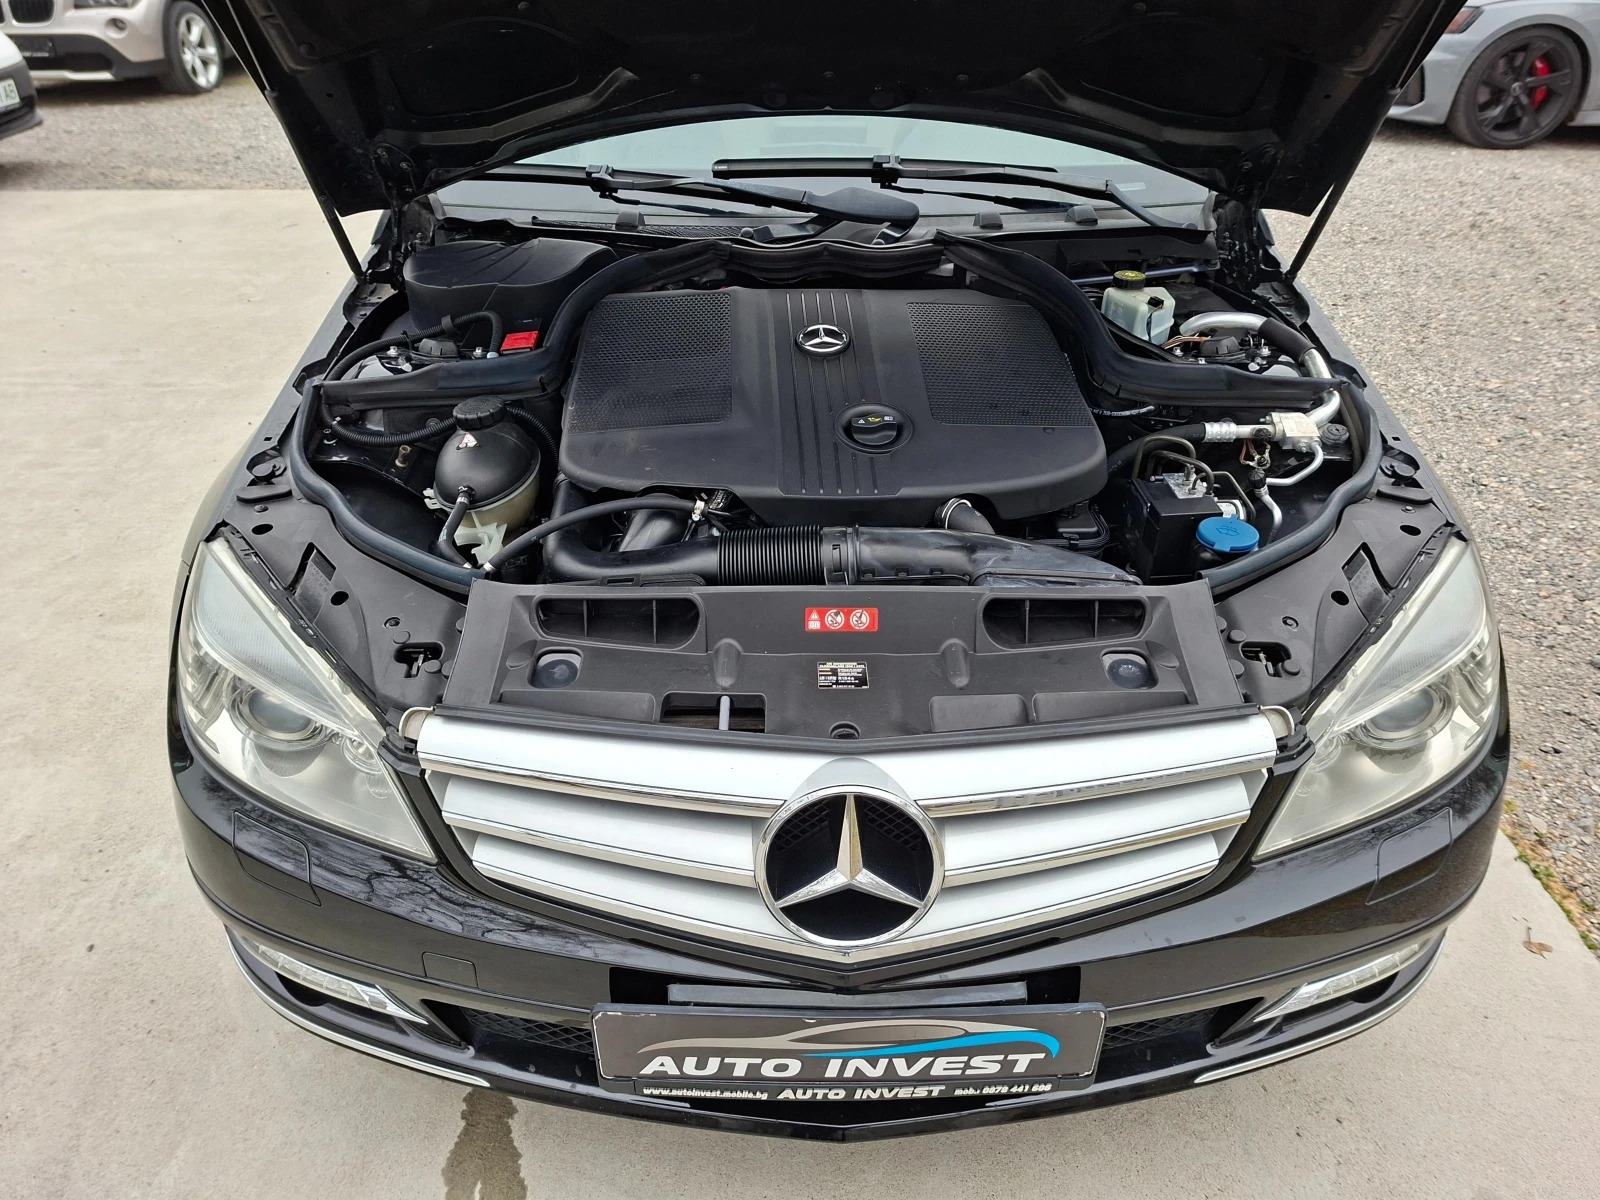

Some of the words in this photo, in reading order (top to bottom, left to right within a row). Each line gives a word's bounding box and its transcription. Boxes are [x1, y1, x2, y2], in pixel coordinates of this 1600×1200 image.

[639, 1055, 802, 1078] AUTO
[824, 1053, 1046, 1078] INVEST
[776, 1087, 846, 1100] AUTO
[853, 1085, 946, 1100] INVEST
